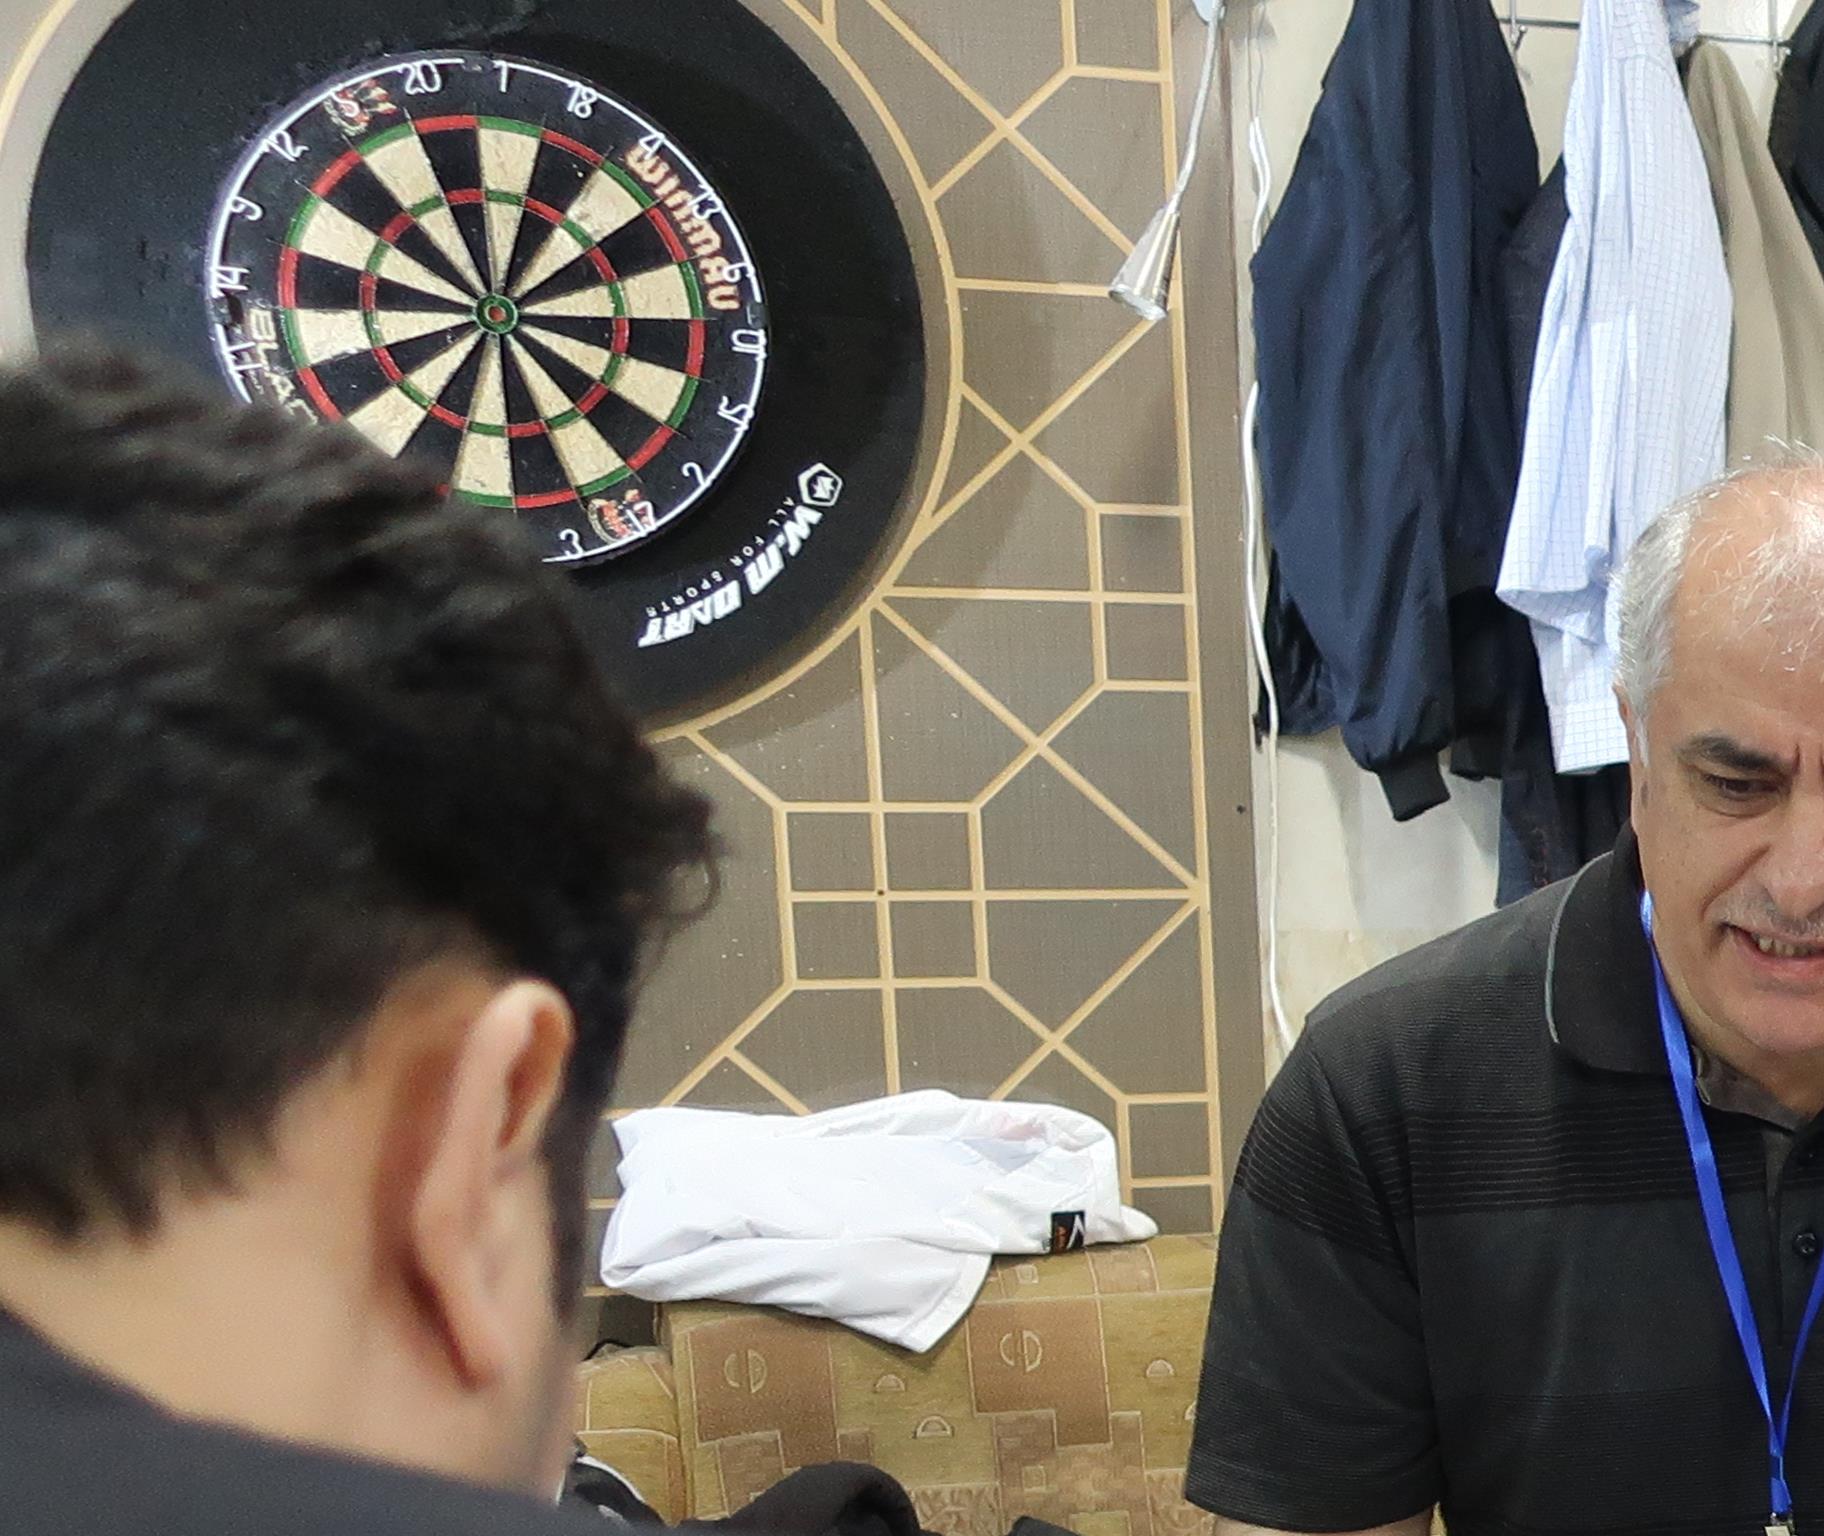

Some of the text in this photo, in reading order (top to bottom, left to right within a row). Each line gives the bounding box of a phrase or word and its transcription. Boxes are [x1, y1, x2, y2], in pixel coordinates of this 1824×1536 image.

[399, 59, 442, 95] 20
[494, 60, 509, 93] 1
[329, 87, 361, 118] 5
[567, 80, 599, 119] 18
[260, 129, 309, 162] 12
[638, 132, 666, 159] 4
[228, 194, 265, 222] 9
[687, 182, 723, 220] 13
[211, 265, 250, 300] 14
[722, 260, 756, 284] 6
[731, 327, 768, 361] 10
[717, 395, 755, 431] 15
[681, 461, 711, 487] 2
[626, 499, 657, 538] 17
[558, 528, 585, 559] 3
[645, 496, 797, 618] ALL FOR SPORTS
[637, 578, 743, 648] DART
